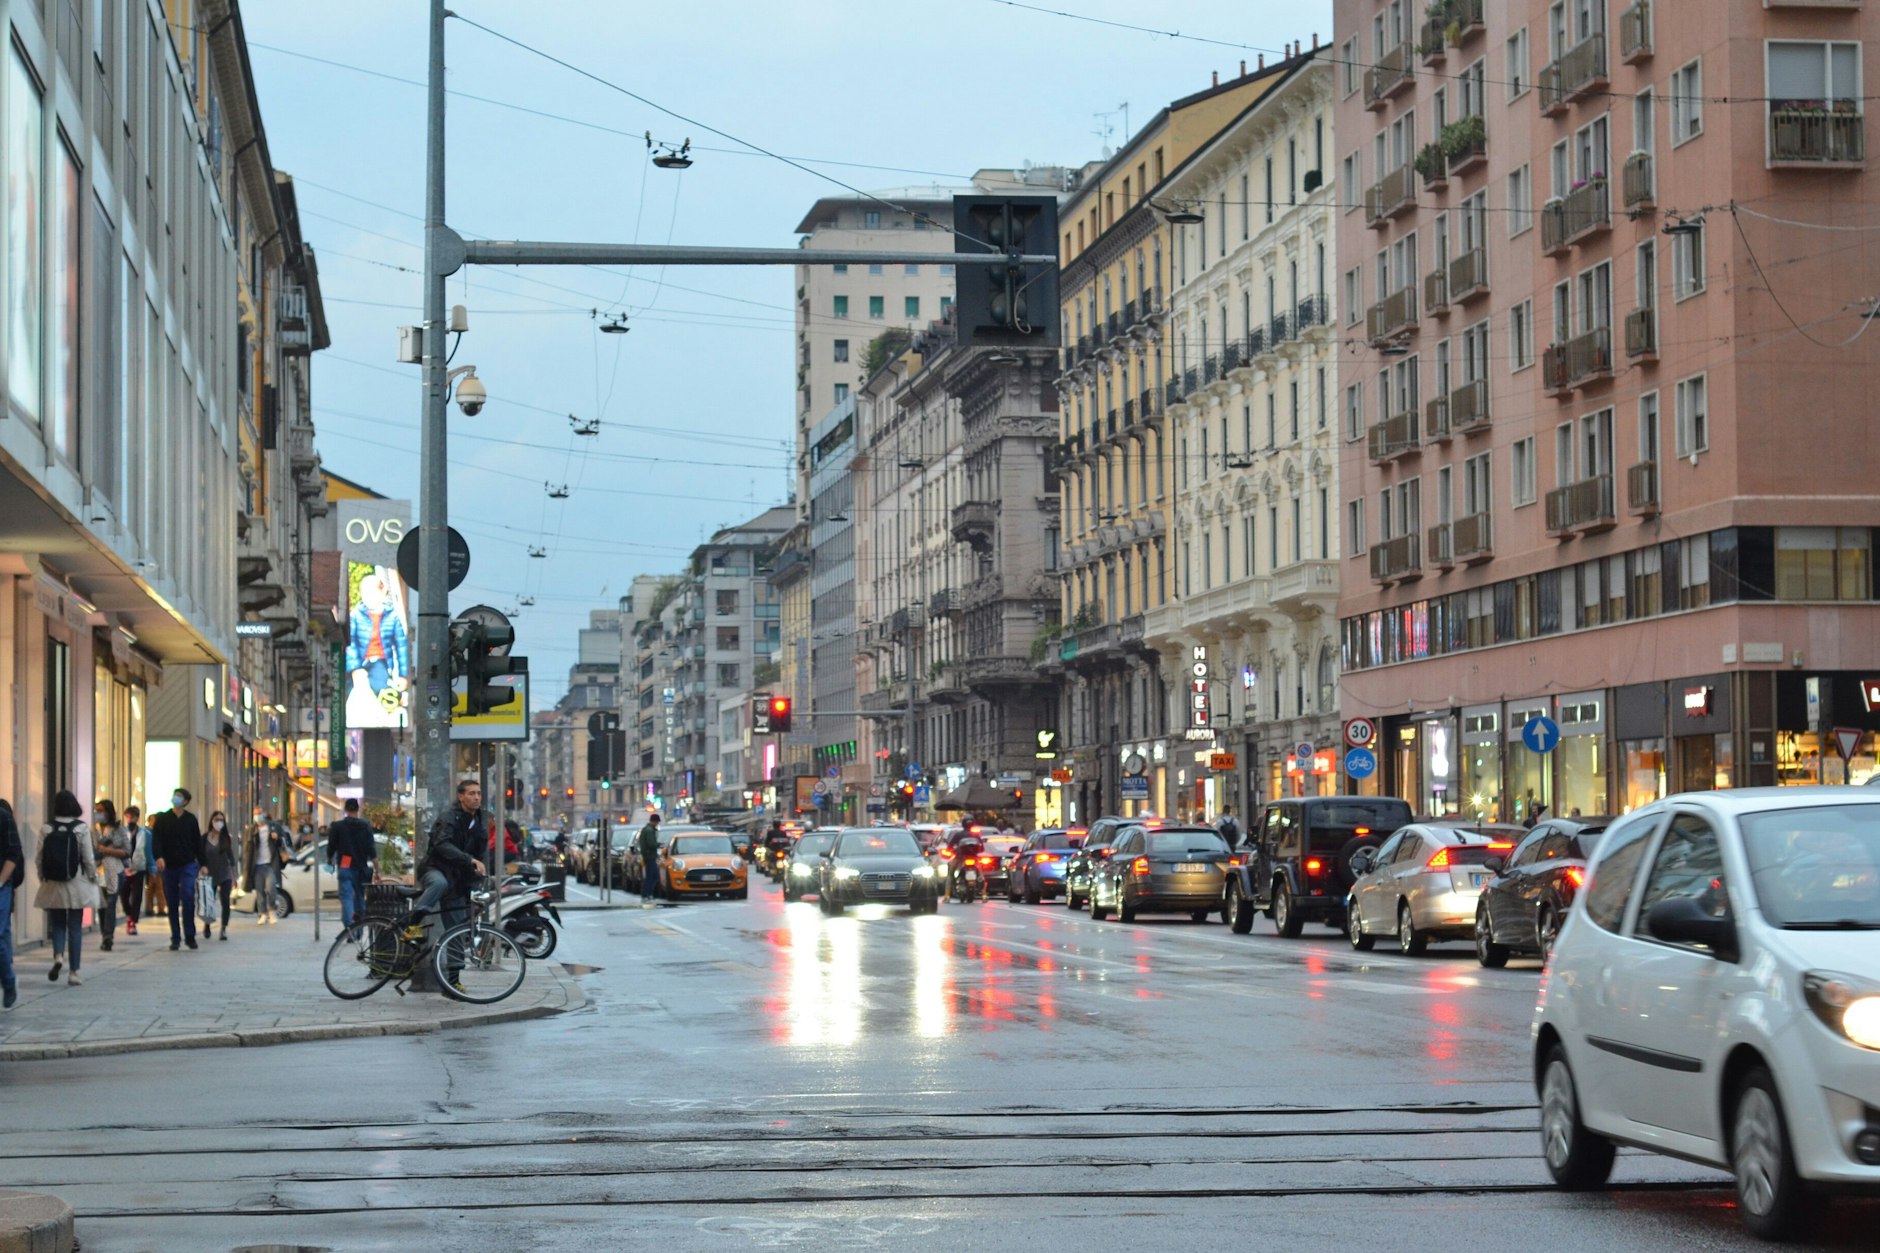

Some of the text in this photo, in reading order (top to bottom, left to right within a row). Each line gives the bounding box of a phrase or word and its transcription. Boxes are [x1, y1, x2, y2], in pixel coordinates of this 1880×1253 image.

[345, 518, 404, 544] OVS
[1193, 646, 1207, 725] HOTEL
[332, 691, 339, 701] OF
[665, 707, 674, 754] HOTEL
[1185, 728, 1216, 741] AURORA
[1351, 725, 1369, 739] 30
[1213, 756, 1234, 766] TAXI
